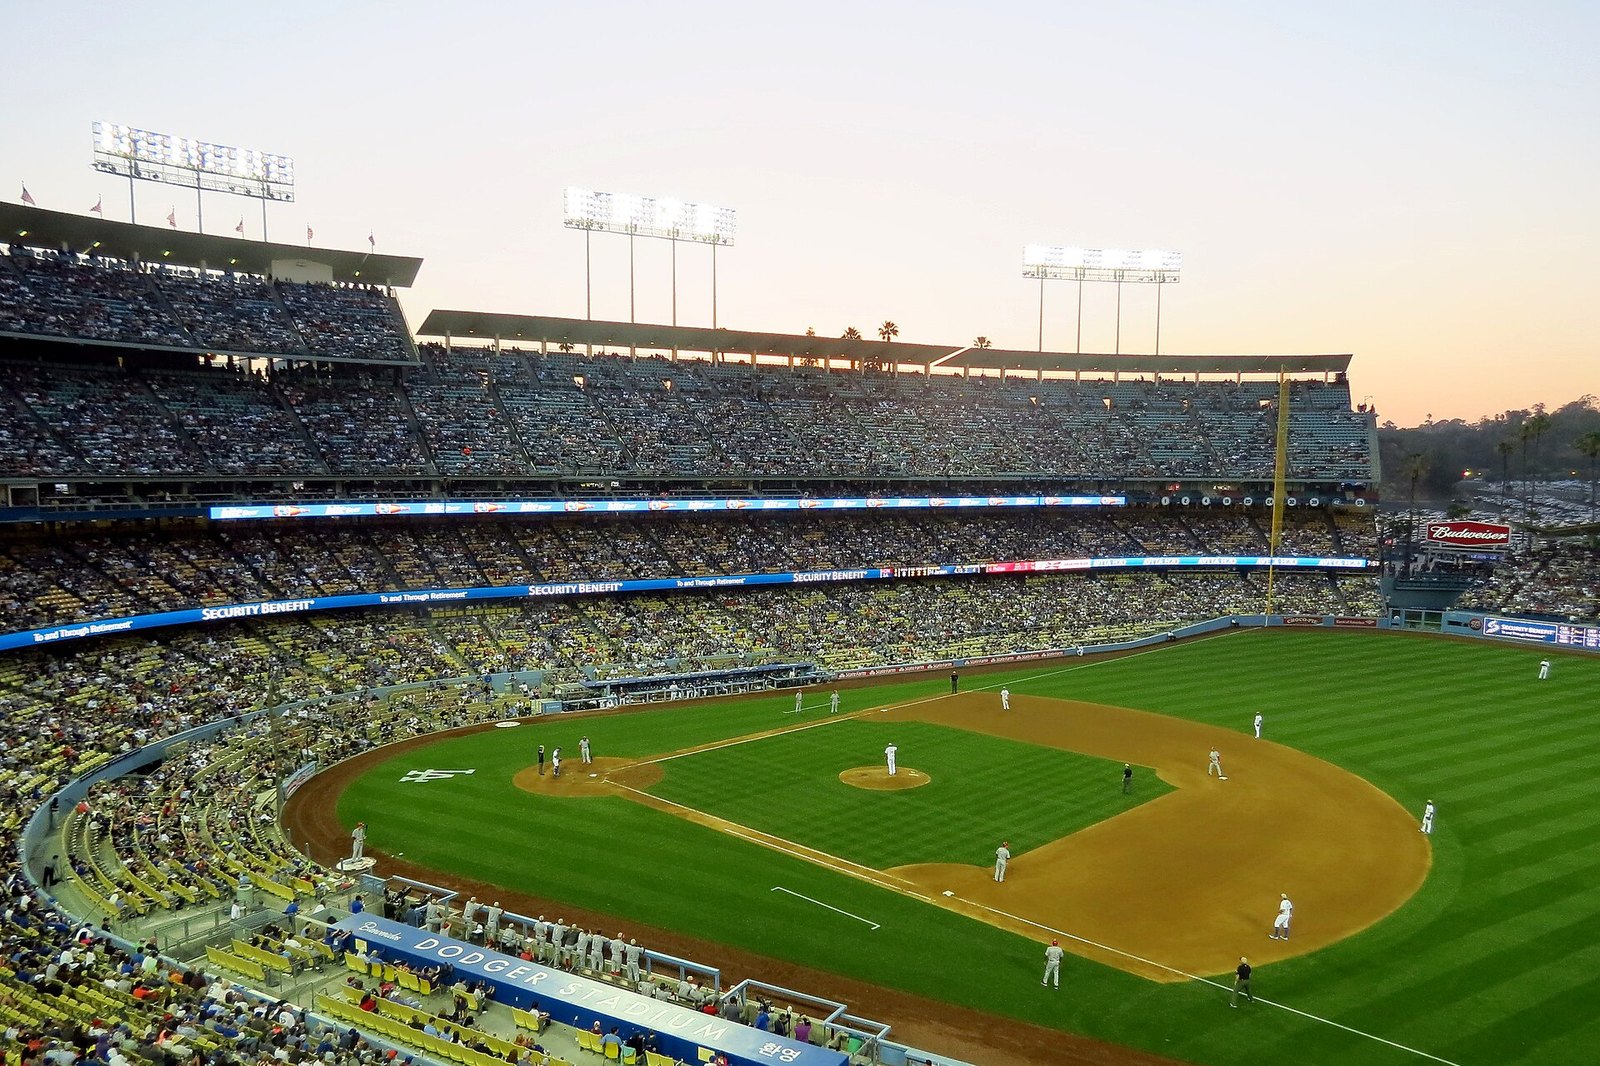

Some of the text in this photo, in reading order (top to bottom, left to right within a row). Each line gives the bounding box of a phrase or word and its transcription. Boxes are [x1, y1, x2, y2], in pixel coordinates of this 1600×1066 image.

[1430, 526, 1508, 540] Budweiser
[793, 571, 865, 583] SECURITY BENEFIT
[403, 593, 429, 601] Through
[430, 591, 466, 599] Retirement
[528, 582, 619, 595] SECURITY BENEFIT
[201, 600, 311, 620] SECURITY BENEFIT
[33, 622, 131, 642] To and Through Retirement
[414, 938, 729, 1041] DODGER STADIUM
[759, 1042, 801, 1062] 환영
